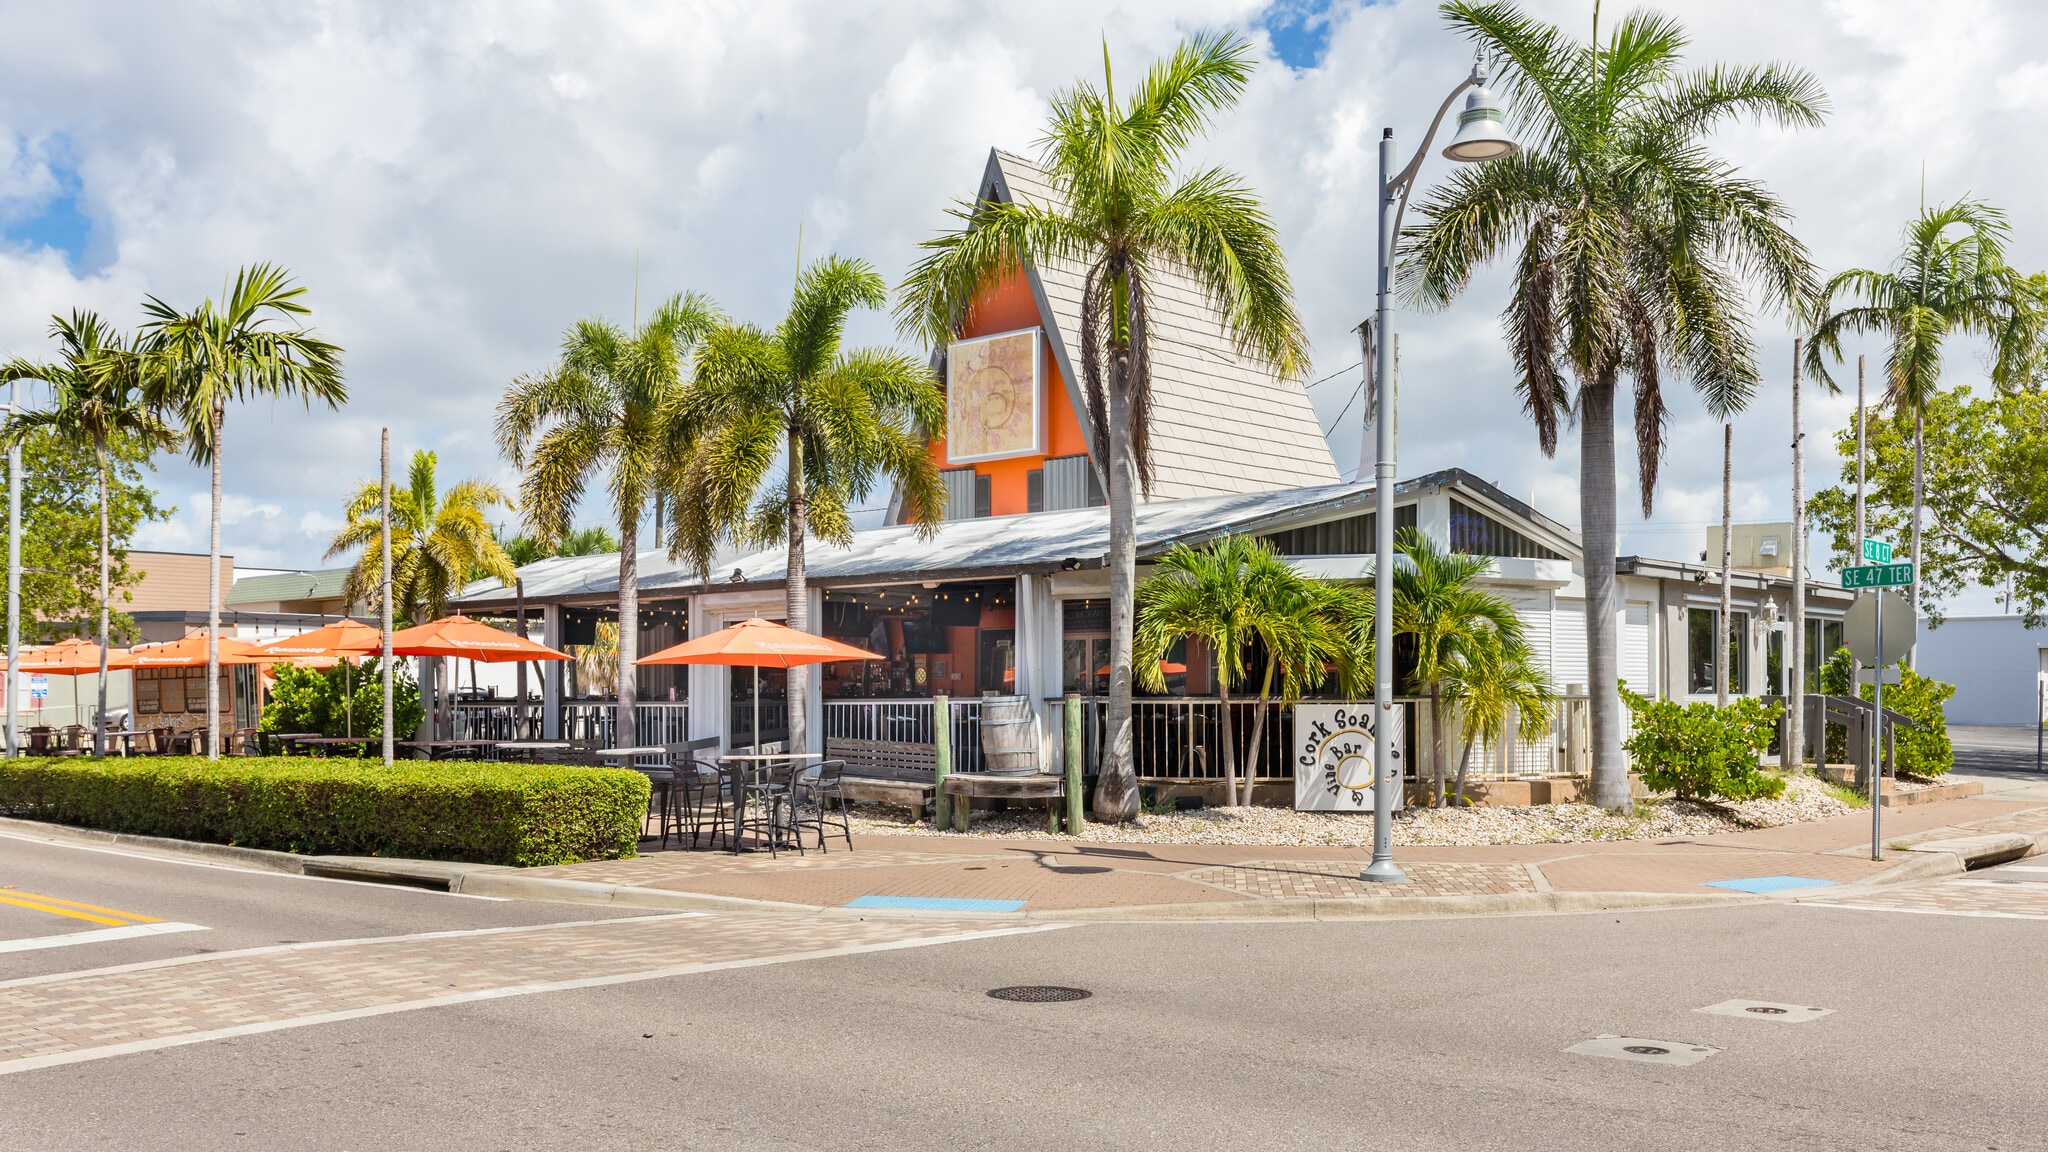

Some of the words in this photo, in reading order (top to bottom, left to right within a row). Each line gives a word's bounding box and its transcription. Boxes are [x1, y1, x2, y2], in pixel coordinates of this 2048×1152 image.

[1865, 541, 1873, 558] SE
[1876, 543, 1880, 561] 8
[1882, 545, 1890, 562] CT
[1845, 569, 1860, 586] SE
[1866, 568, 1883, 584] 47
[1889, 566, 1911, 583] TER
[1300, 720, 1331, 766] Cork
[1330, 743, 1361, 761] Bar
